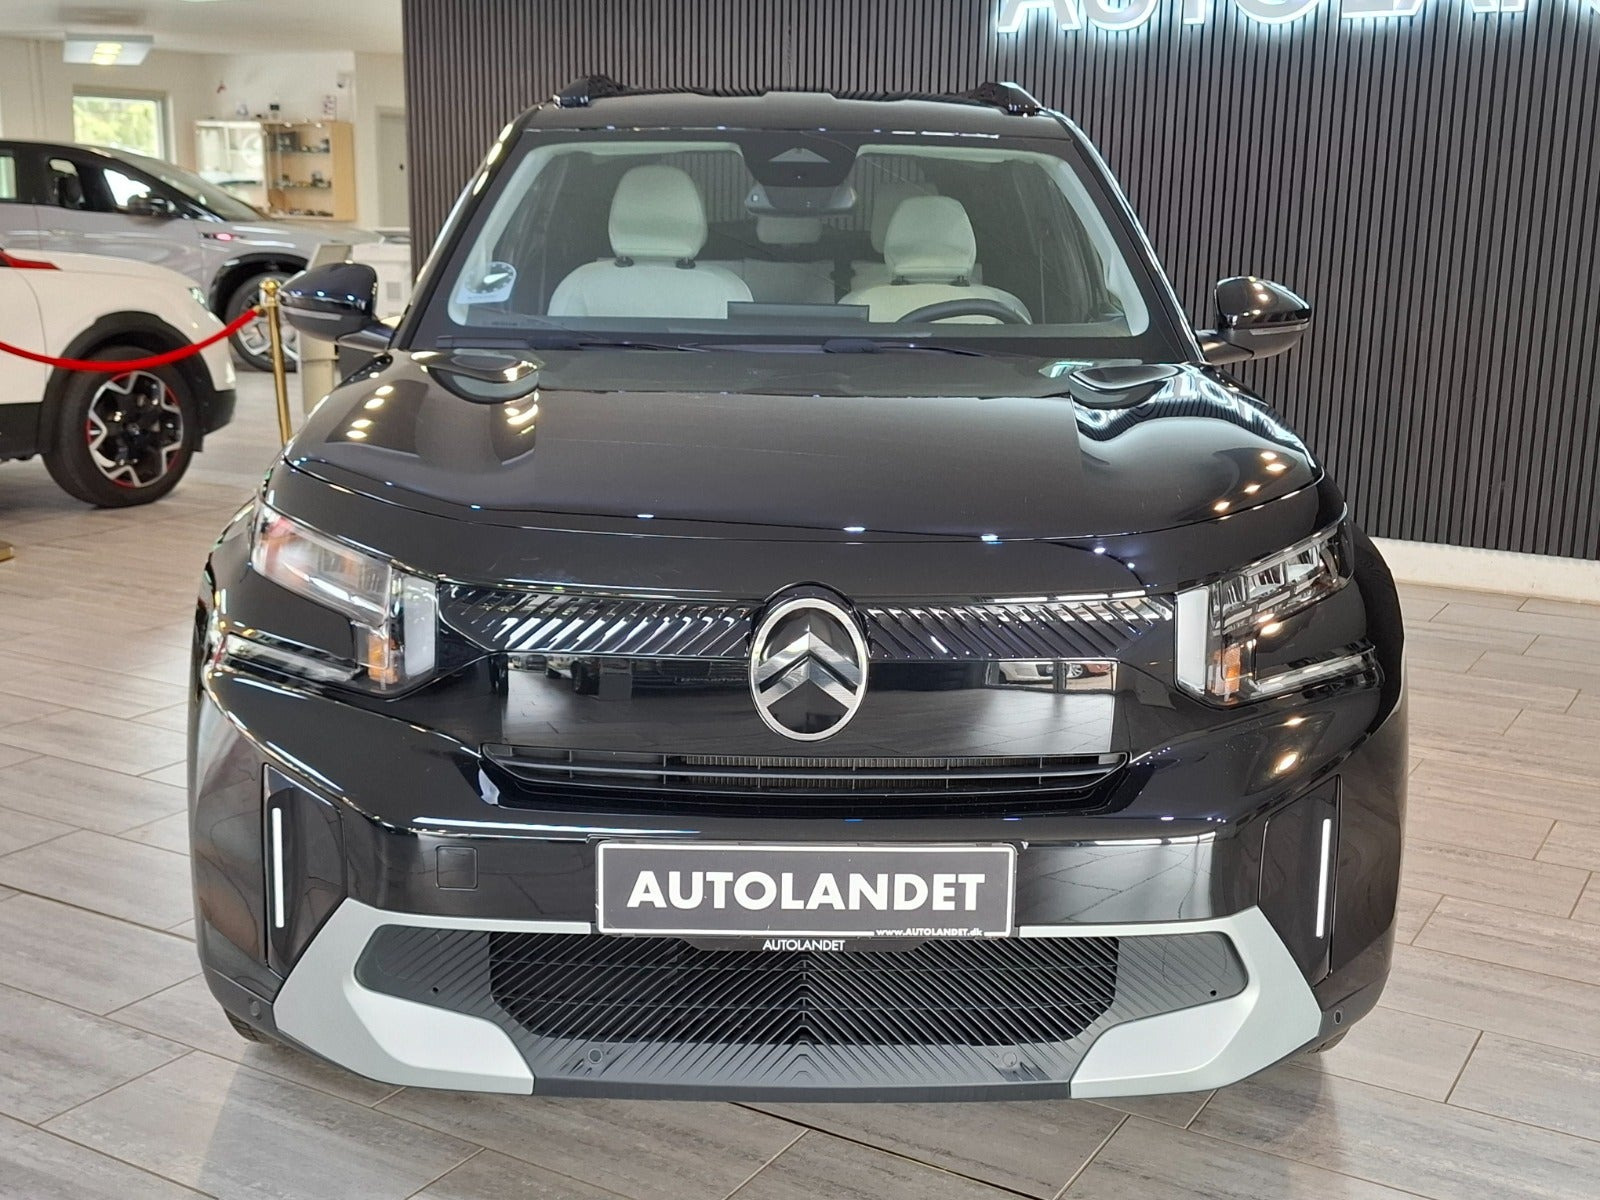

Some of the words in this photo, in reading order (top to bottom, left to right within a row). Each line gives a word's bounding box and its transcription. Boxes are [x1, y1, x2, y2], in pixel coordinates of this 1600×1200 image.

[626, 870, 986, 911] AUTOLANDET
[876, 927, 982, 937] www.AUTOLANDET.dk
[762, 939, 846, 951] AUTOLANDET
